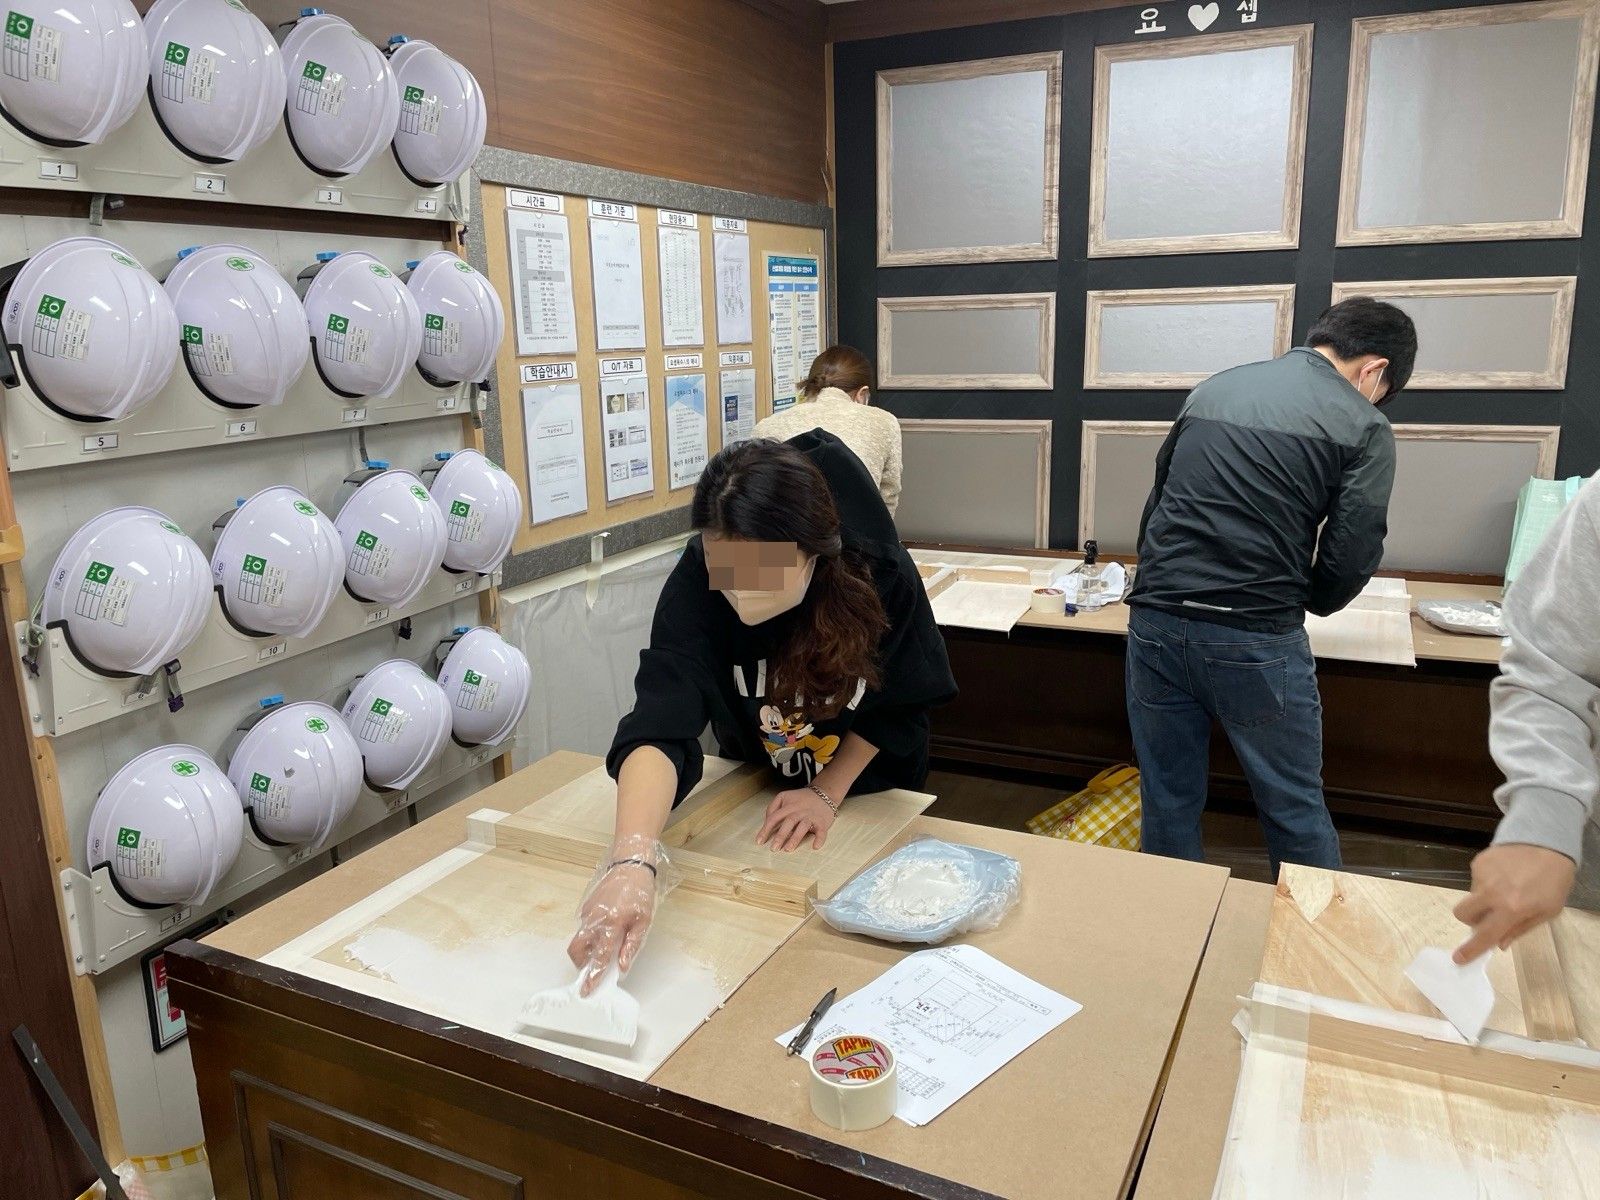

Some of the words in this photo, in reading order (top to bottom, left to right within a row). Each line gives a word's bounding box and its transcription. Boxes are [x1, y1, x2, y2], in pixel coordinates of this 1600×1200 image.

[1134, 7, 1166, 34] 요
[57, 165, 62, 174] 1
[207, 180, 212, 189] 2
[328, 192, 332, 200] 3
[526, 196, 545, 207] 시간표
[600, 204, 612, 215] 훈련
[614, 205, 626, 216] 기준
[623, 361, 634, 370] 자료
[530, 366, 569, 379] 학습안내서
[240, 424, 246, 432] 6
[98, 438, 104, 446] 5
[269, 647, 277, 655] 10
[171, 913, 182, 923] 13
